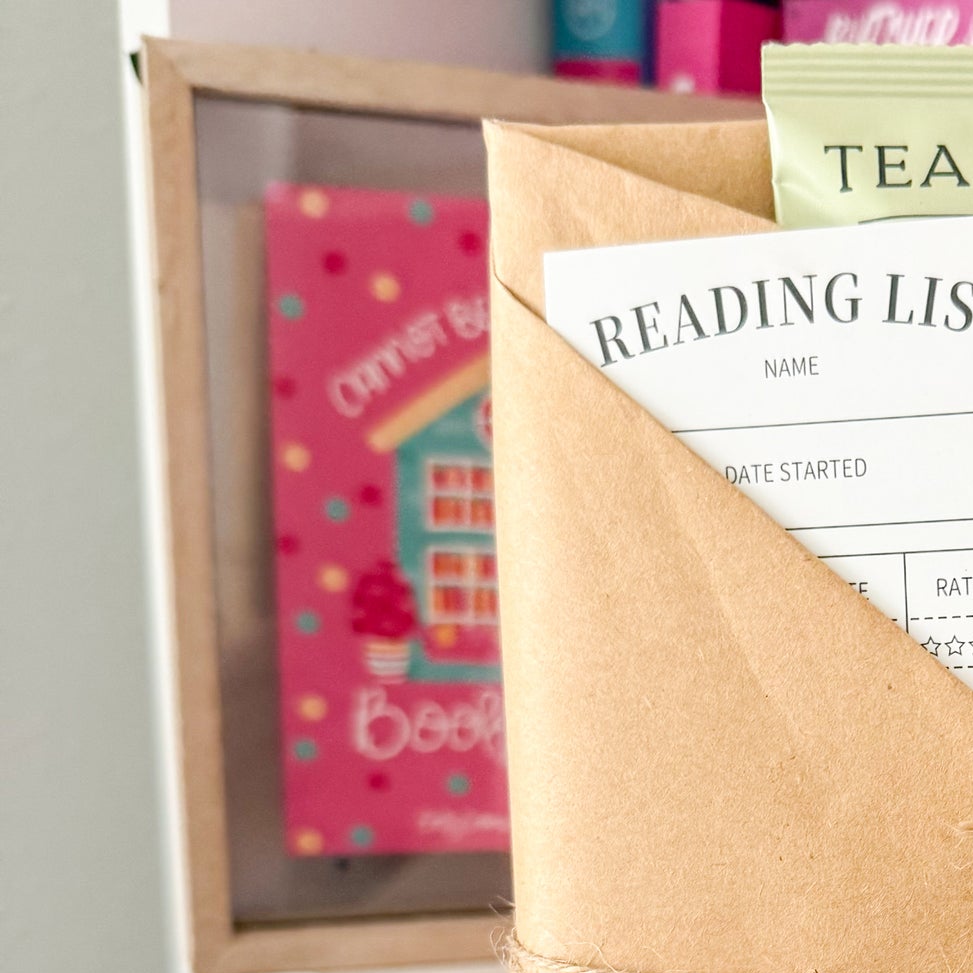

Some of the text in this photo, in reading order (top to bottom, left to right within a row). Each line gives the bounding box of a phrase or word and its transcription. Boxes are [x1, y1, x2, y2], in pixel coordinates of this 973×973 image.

[824, 144, 970, 193] TEA
[589, 272, 863, 368] READING
[764, 355, 820, 378] NAME
[725, 458, 867, 485] DATE STARTED
